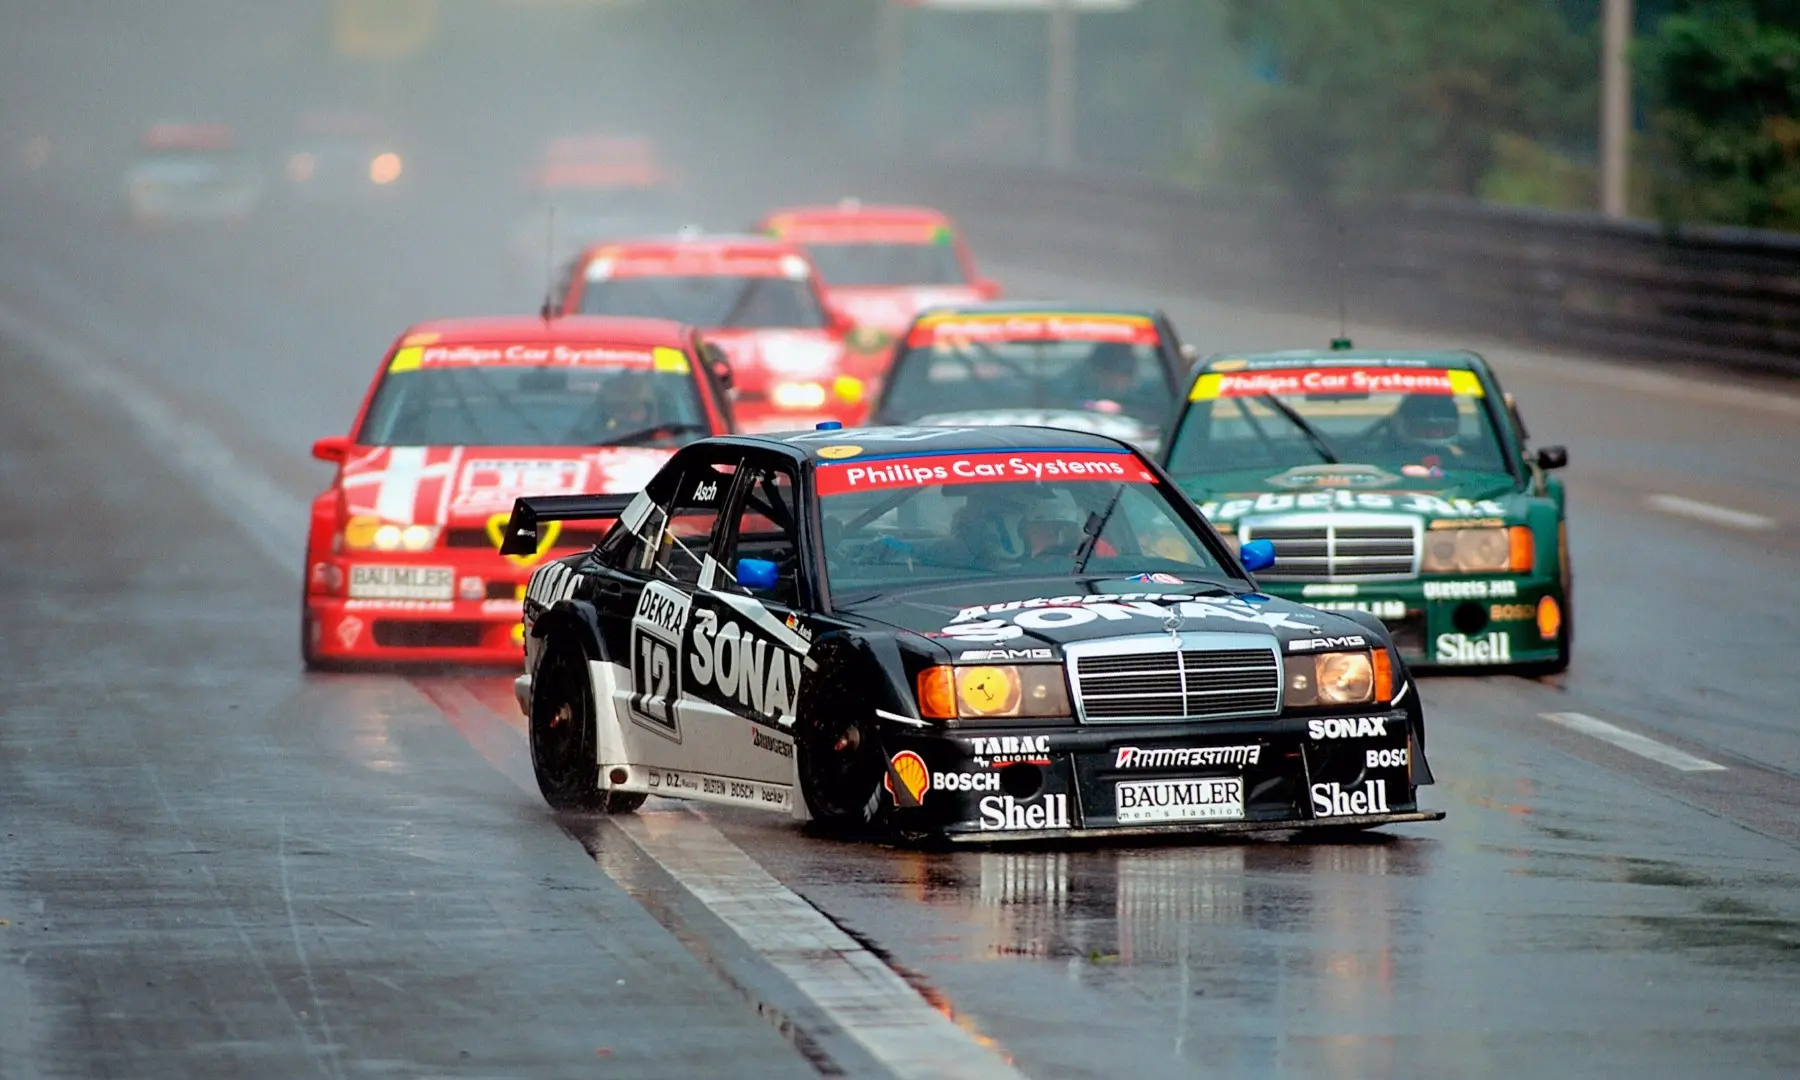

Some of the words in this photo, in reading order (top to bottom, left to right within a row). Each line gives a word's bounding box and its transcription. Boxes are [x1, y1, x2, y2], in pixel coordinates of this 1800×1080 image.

[1220, 373, 1298, 393] Philips
[1303, 371, 1348, 387] Car
[1352, 370, 1451, 389] Systems
[846, 463, 948, 485] Philips
[952, 458, 1005, 478] Car
[1008, 457, 1125, 480] Systems
[692, 480, 718, 501] Asch
[639, 588, 684, 636] DEKRA
[941, 602, 1317, 642] SONAX
[1311, 635, 1365, 649] AMG
[1436, 631, 1510, 664] Shell
[987, 649, 1053, 660] AMG
[640, 636, 671, 722] 12
[1308, 716, 1388, 739] SONAX
[971, 735, 1050, 755] TABAC
[1115, 744, 1261, 769] BRIDGESTONE
[993, 753, 1049, 763] ORIGINAL
[730, 782, 754, 800] BOSCH
[933, 772, 1000, 791] BOSCH
[761, 786, 784, 804] becker
[1120, 782, 1241, 809] BÄUMLER
[1311, 779, 1391, 818] Shell
[978, 793, 1072, 831] Shell
